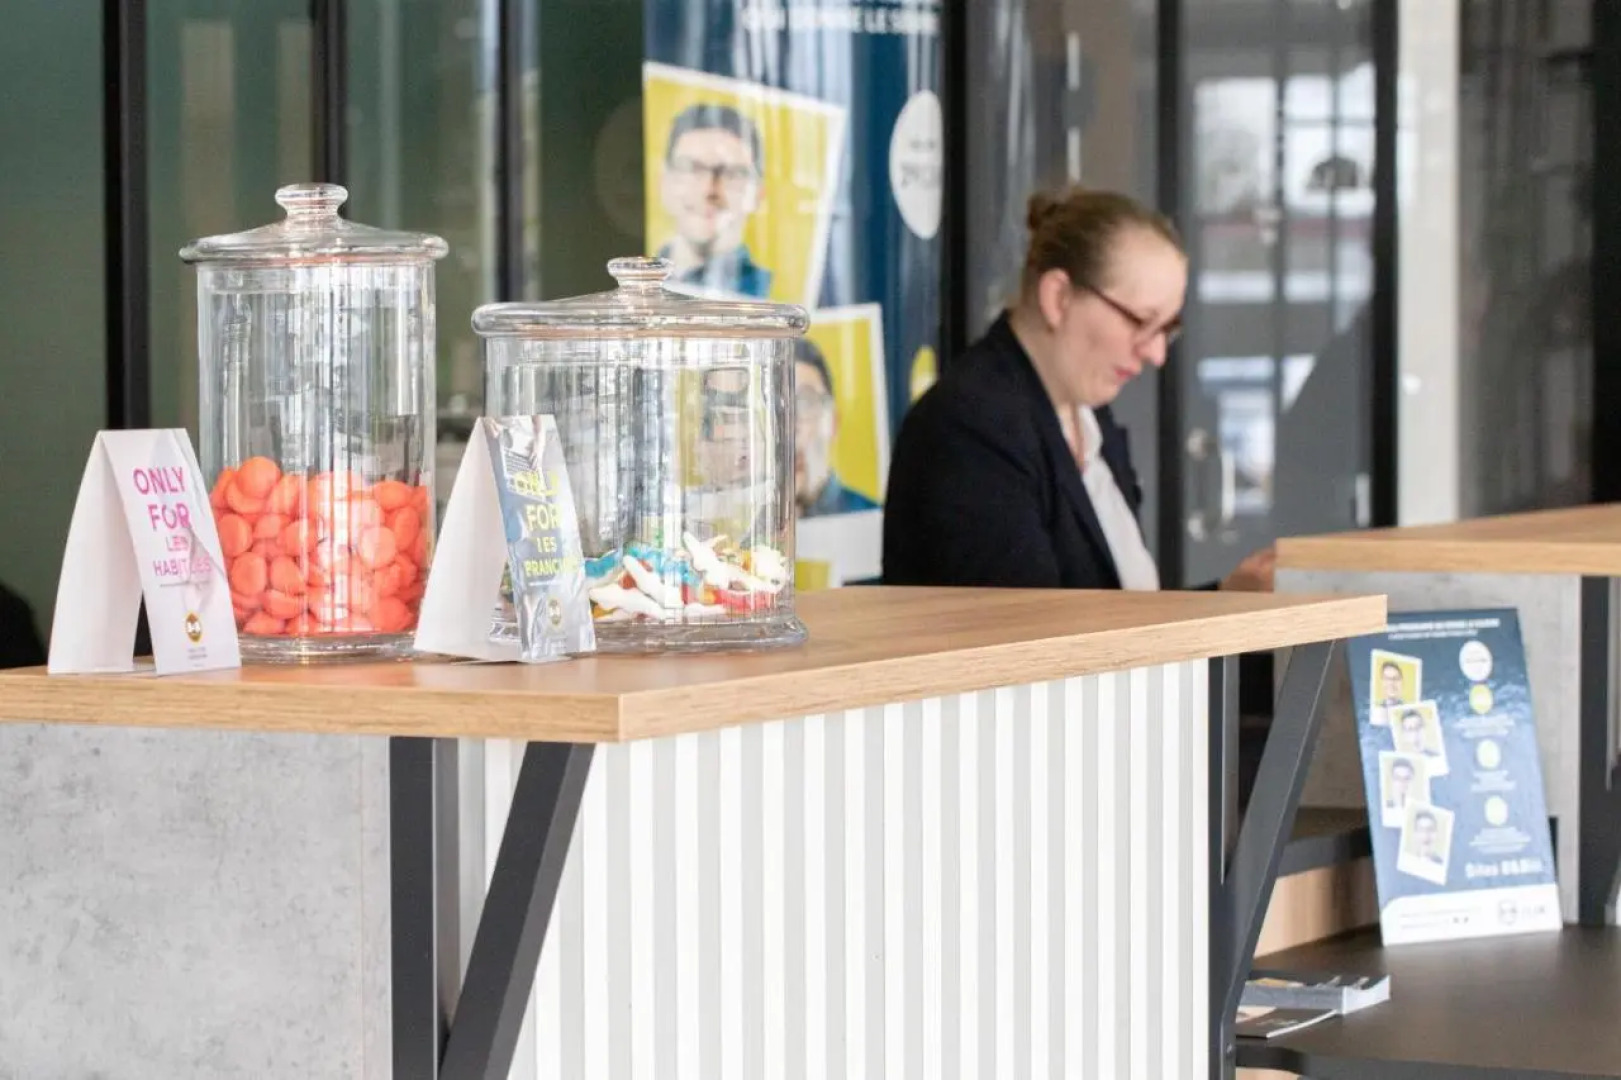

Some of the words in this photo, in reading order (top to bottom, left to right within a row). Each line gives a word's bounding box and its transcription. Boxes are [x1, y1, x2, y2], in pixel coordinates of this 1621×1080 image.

[133, 466, 186, 494] ONLY
[148, 503, 191, 531] FOR
[525, 503, 563, 531] FOR
